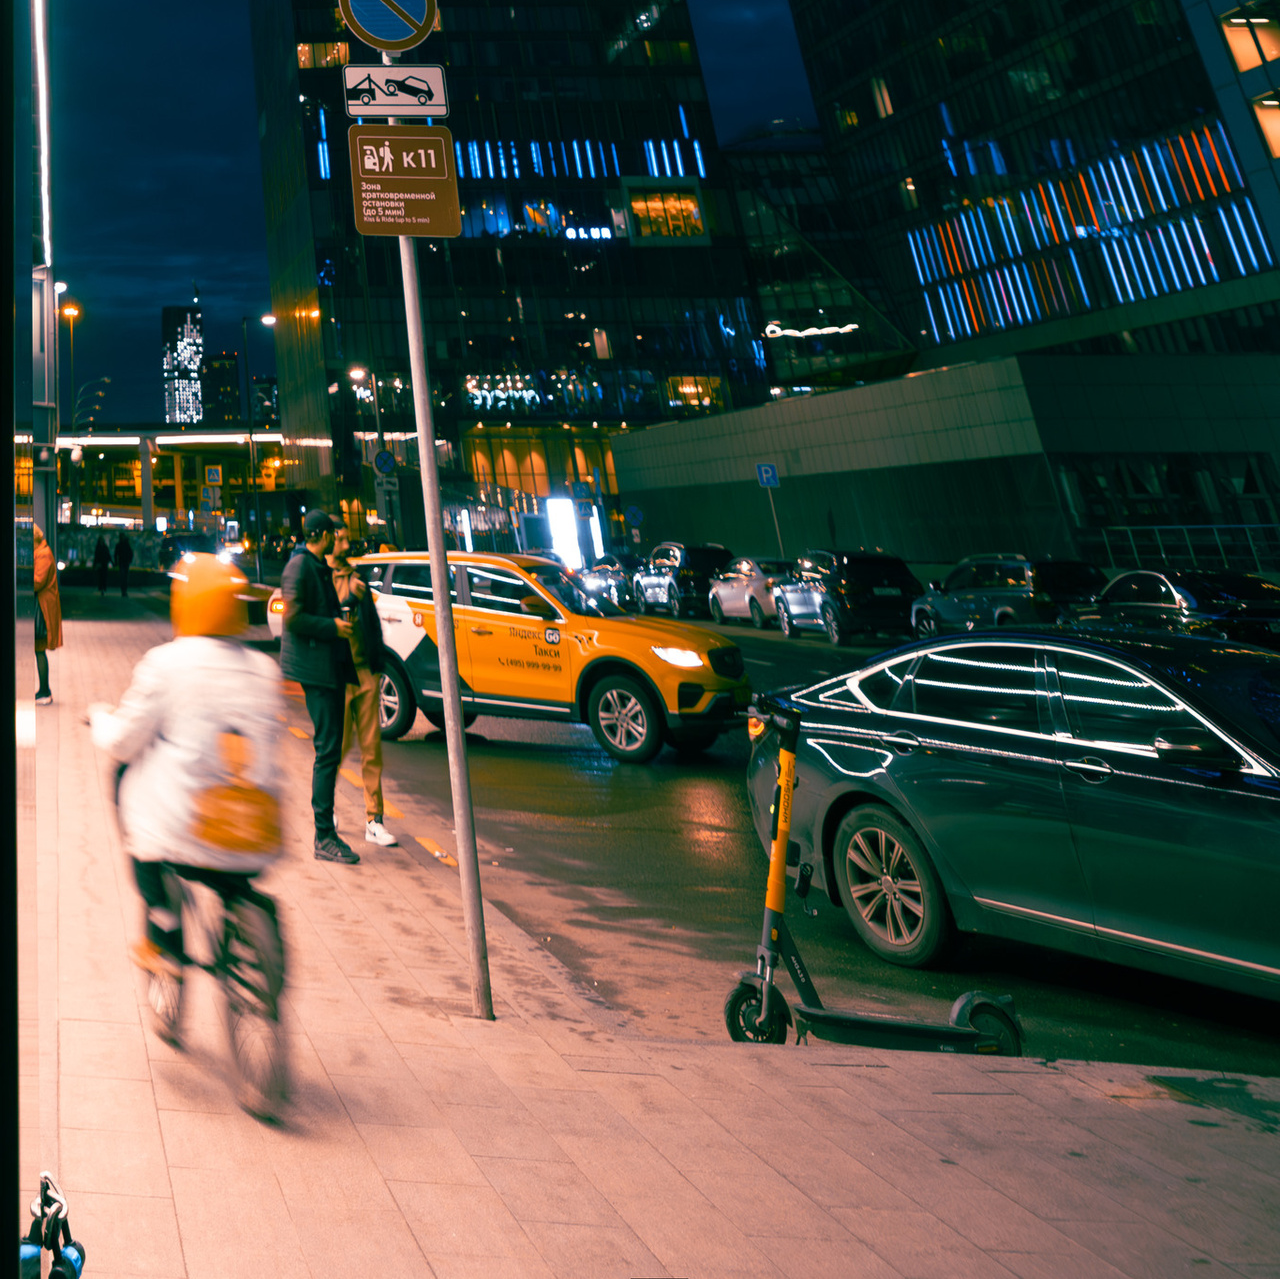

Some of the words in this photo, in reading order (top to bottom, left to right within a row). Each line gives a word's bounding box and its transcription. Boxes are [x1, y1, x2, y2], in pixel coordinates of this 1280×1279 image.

[361, 181, 382, 191] Зона
[361, 191, 436, 201] кратковременной
[362, 200, 405, 208] остановки
[363, 208, 377, 217] (до
[378, 208, 384, 216] 5
[385, 208, 406, 217] мин)
[761, 466, 773, 484] P
[508, 626, 543, 642] Яндекс
[533, 644, 561, 659] Такси
[782, 779, 792, 824] WHOOSH
